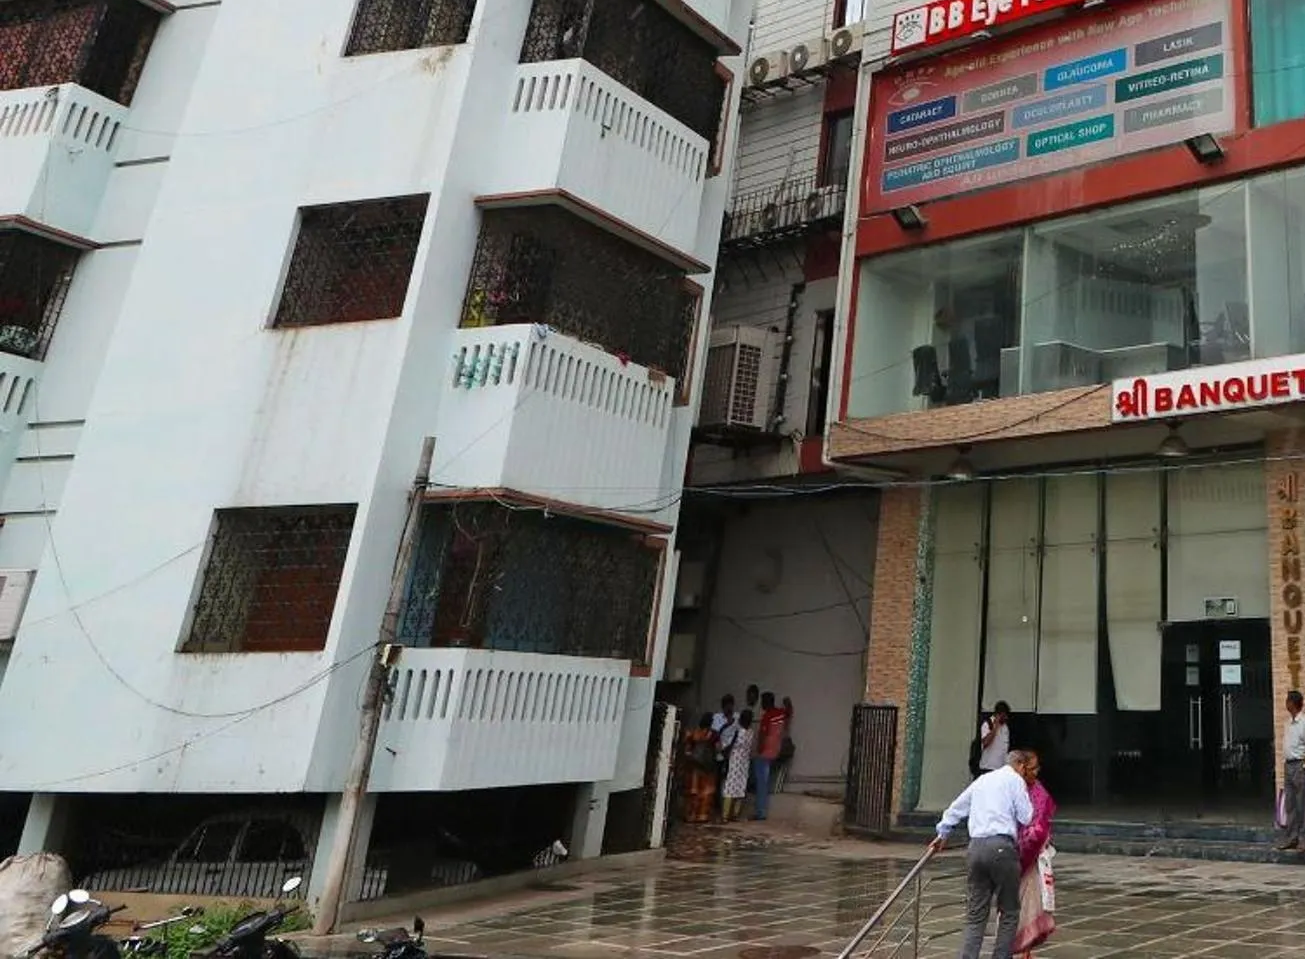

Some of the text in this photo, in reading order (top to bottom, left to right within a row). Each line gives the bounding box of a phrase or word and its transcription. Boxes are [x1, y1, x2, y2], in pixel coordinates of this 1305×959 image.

[1163, 38, 1194, 52] LASIK
[1057, 58, 1114, 82] GLAUCOMA
[1128, 64, 1210, 92] VITREO-RETINA
[900, 106, 943, 125] CATARACT
[1142, 100, 1202, 122] PHARMACY
[1035, 122, 1107, 149] OPTICAL SHOP
